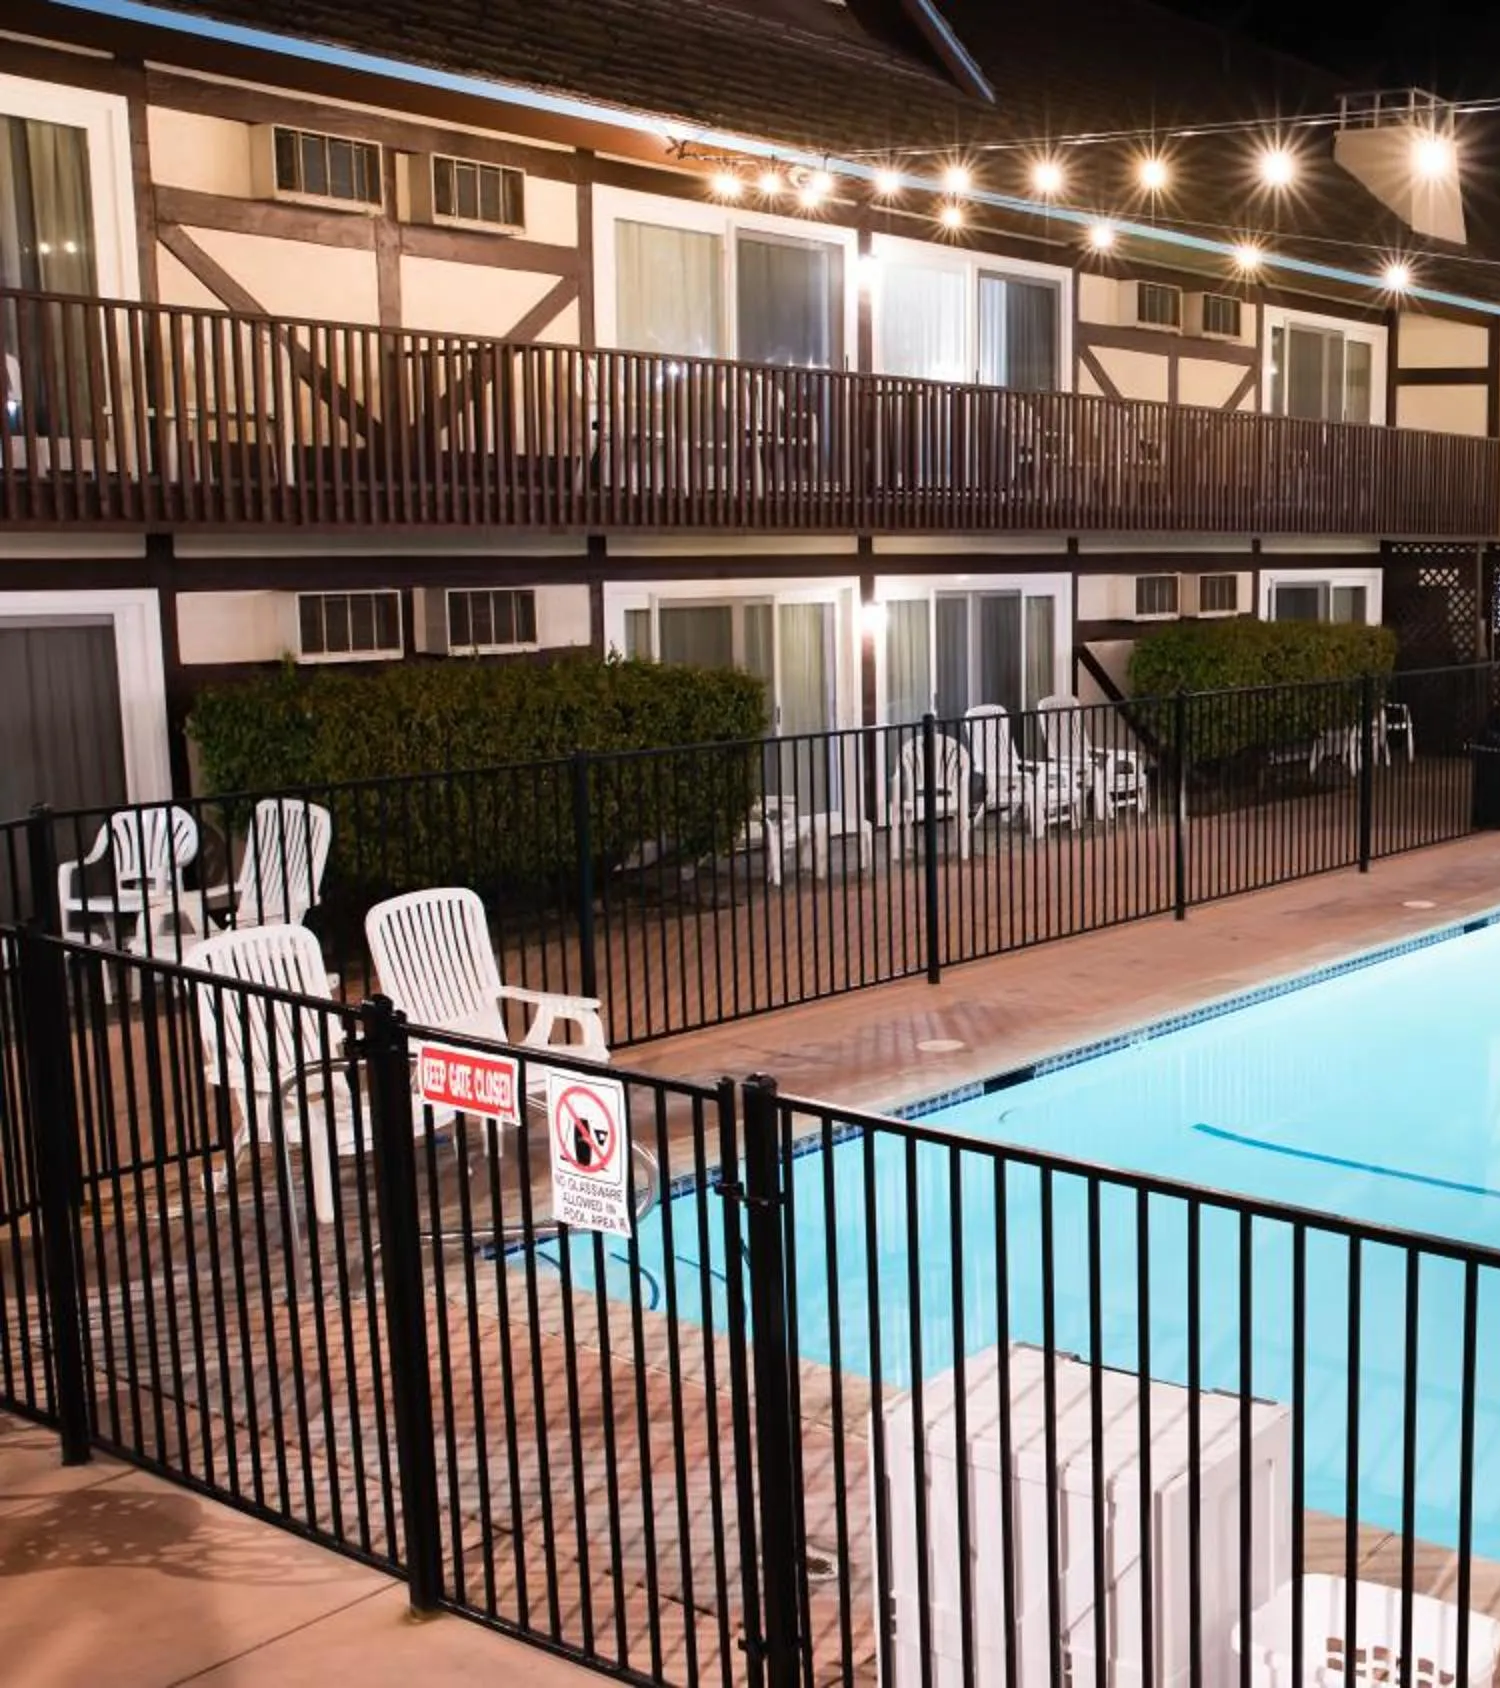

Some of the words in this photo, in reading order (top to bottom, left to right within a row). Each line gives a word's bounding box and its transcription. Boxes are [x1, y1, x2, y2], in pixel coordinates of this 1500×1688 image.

[423, 1058, 446, 1094] KEEP
[449, 1062, 473, 1100] GATE
[474, 1067, 511, 1108] CLOSED
[563, 1191, 603, 1213] ALLOWED
[568, 1178, 623, 1203] GLASSWARE
[563, 1206, 585, 1223] POOL
[591, 1213, 617, 1230] AREA
